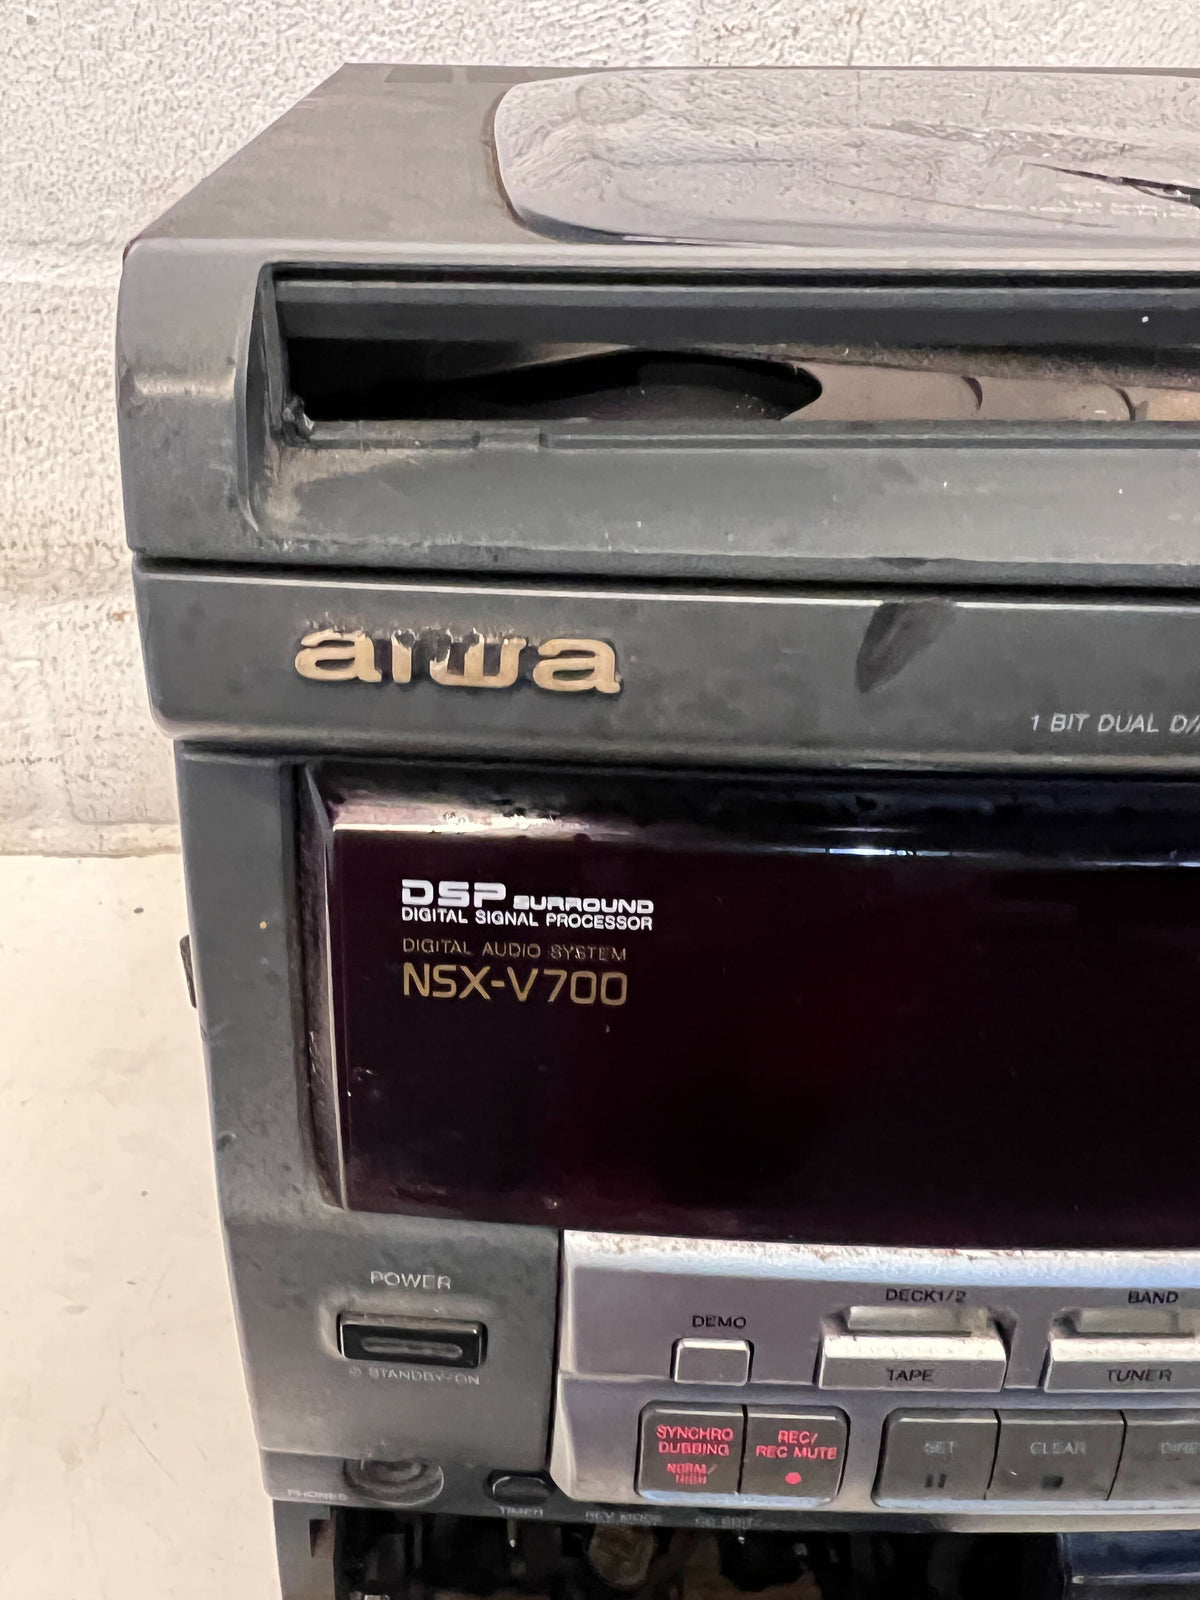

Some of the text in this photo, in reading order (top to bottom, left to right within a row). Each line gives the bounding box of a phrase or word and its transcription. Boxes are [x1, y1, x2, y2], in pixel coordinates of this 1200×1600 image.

[295, 629, 620, 694] aiwa
[1031, 712, 1200, 733] 1 BIT DUAL D/
[402, 879, 655, 914] DSP SURROUND
[402, 907, 653, 931] DIGITAL SIGNAL PROCESSOR
[403, 938, 627, 961] DIGITAL AUDIO SYSTEM
[403, 962, 628, 1006] NSX-V700
[370, 1271, 451, 1290] POWER
[1128, 1290, 1179, 1305] BAND
[692, 1315, 748, 1329] DEMO
[888, 1369, 935, 1383] TAPE
[1107, 1369, 1173, 1382] TUNER
[656, 1424, 734, 1442] SYNCHRO
[778, 1430, 819, 1444] REC/
[658, 1442, 730, 1457] DUBBING
[755, 1445, 838, 1460] REC MUTE
[1030, 1442, 1087, 1456] CLEAR
